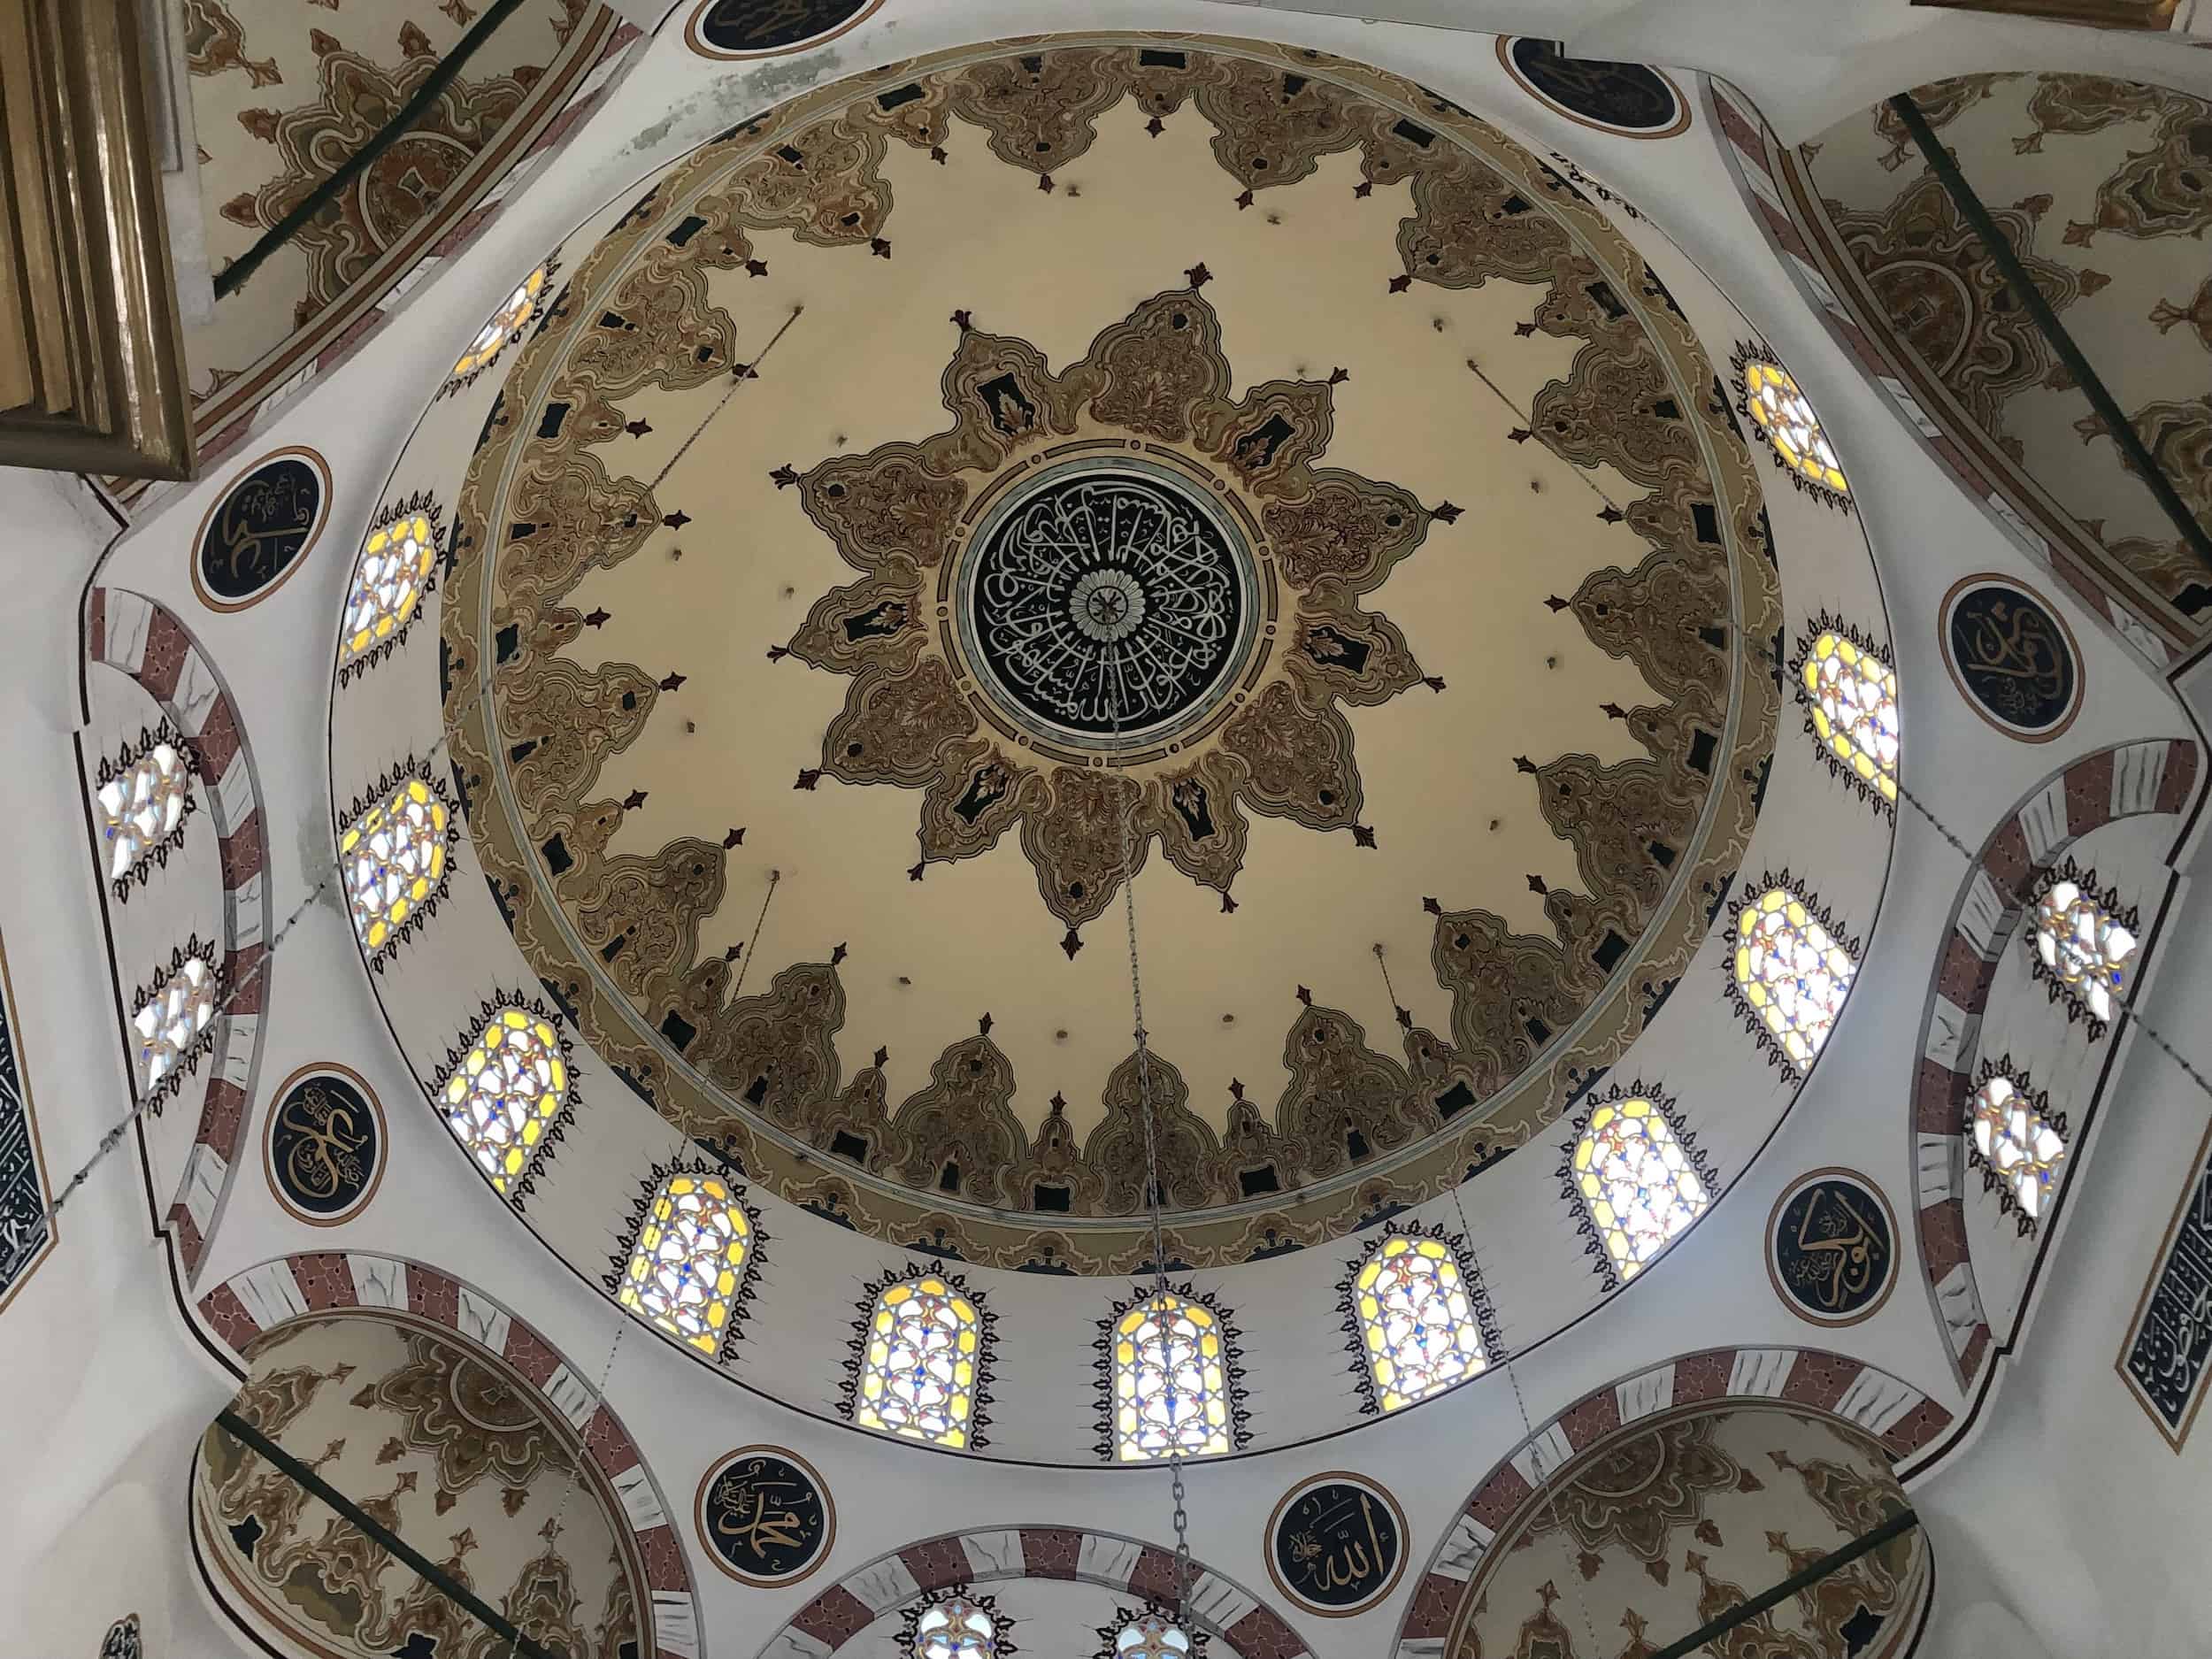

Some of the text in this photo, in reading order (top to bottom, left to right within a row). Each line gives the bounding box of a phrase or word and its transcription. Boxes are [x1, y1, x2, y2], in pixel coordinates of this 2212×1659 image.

[283, 1109, 354, 1198] عمر
[718, 1490, 803, 1558] محمد
[1315, 1493, 1384, 1591] الله
